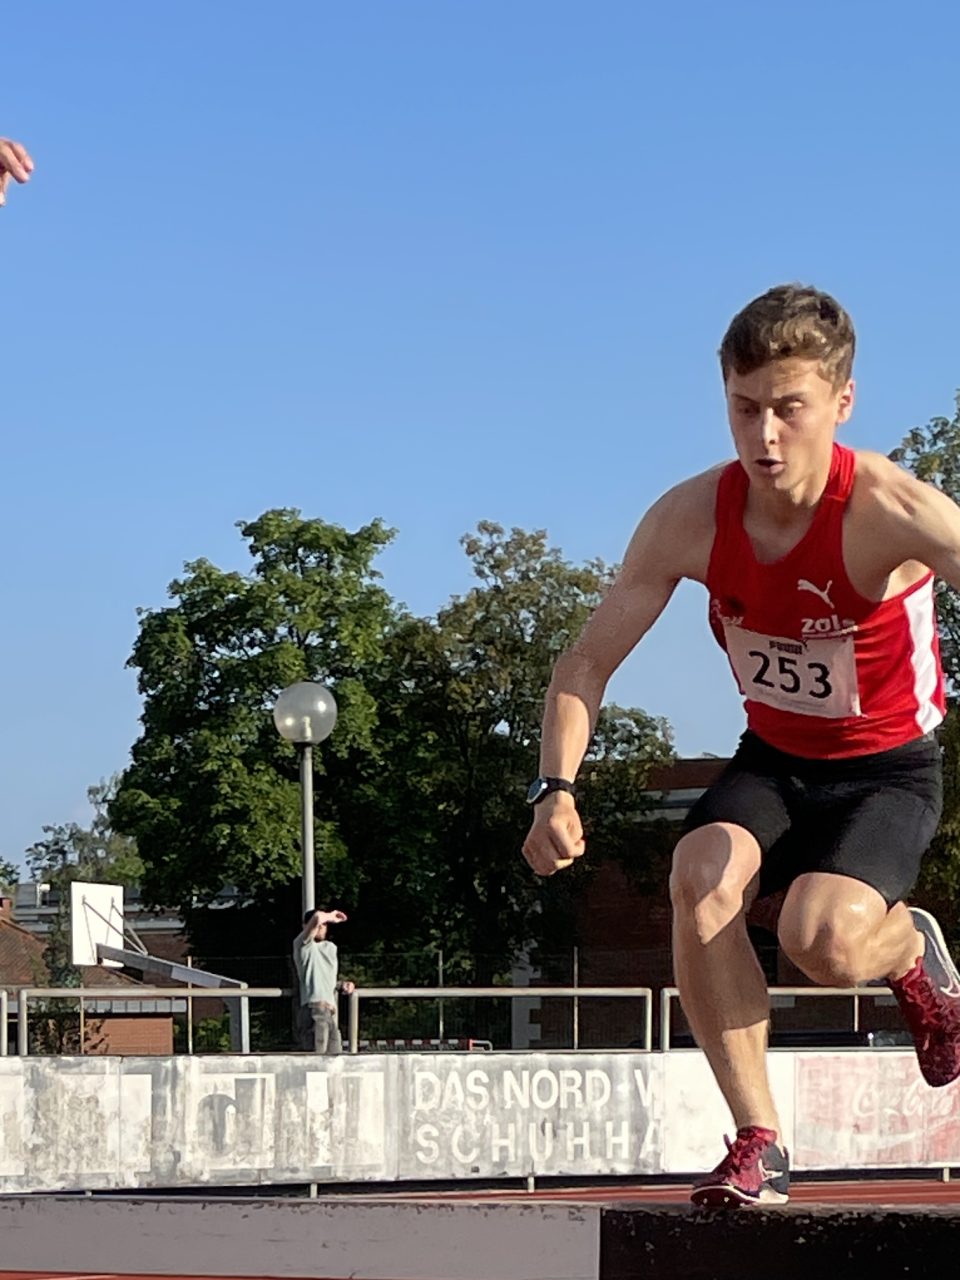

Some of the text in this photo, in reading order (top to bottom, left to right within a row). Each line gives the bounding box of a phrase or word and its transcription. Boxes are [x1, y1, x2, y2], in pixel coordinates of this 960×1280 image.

[748, 650, 832, 699] 253
[414, 1069, 490, 1111] DAS
[503, 1069, 611, 1110] NORD
